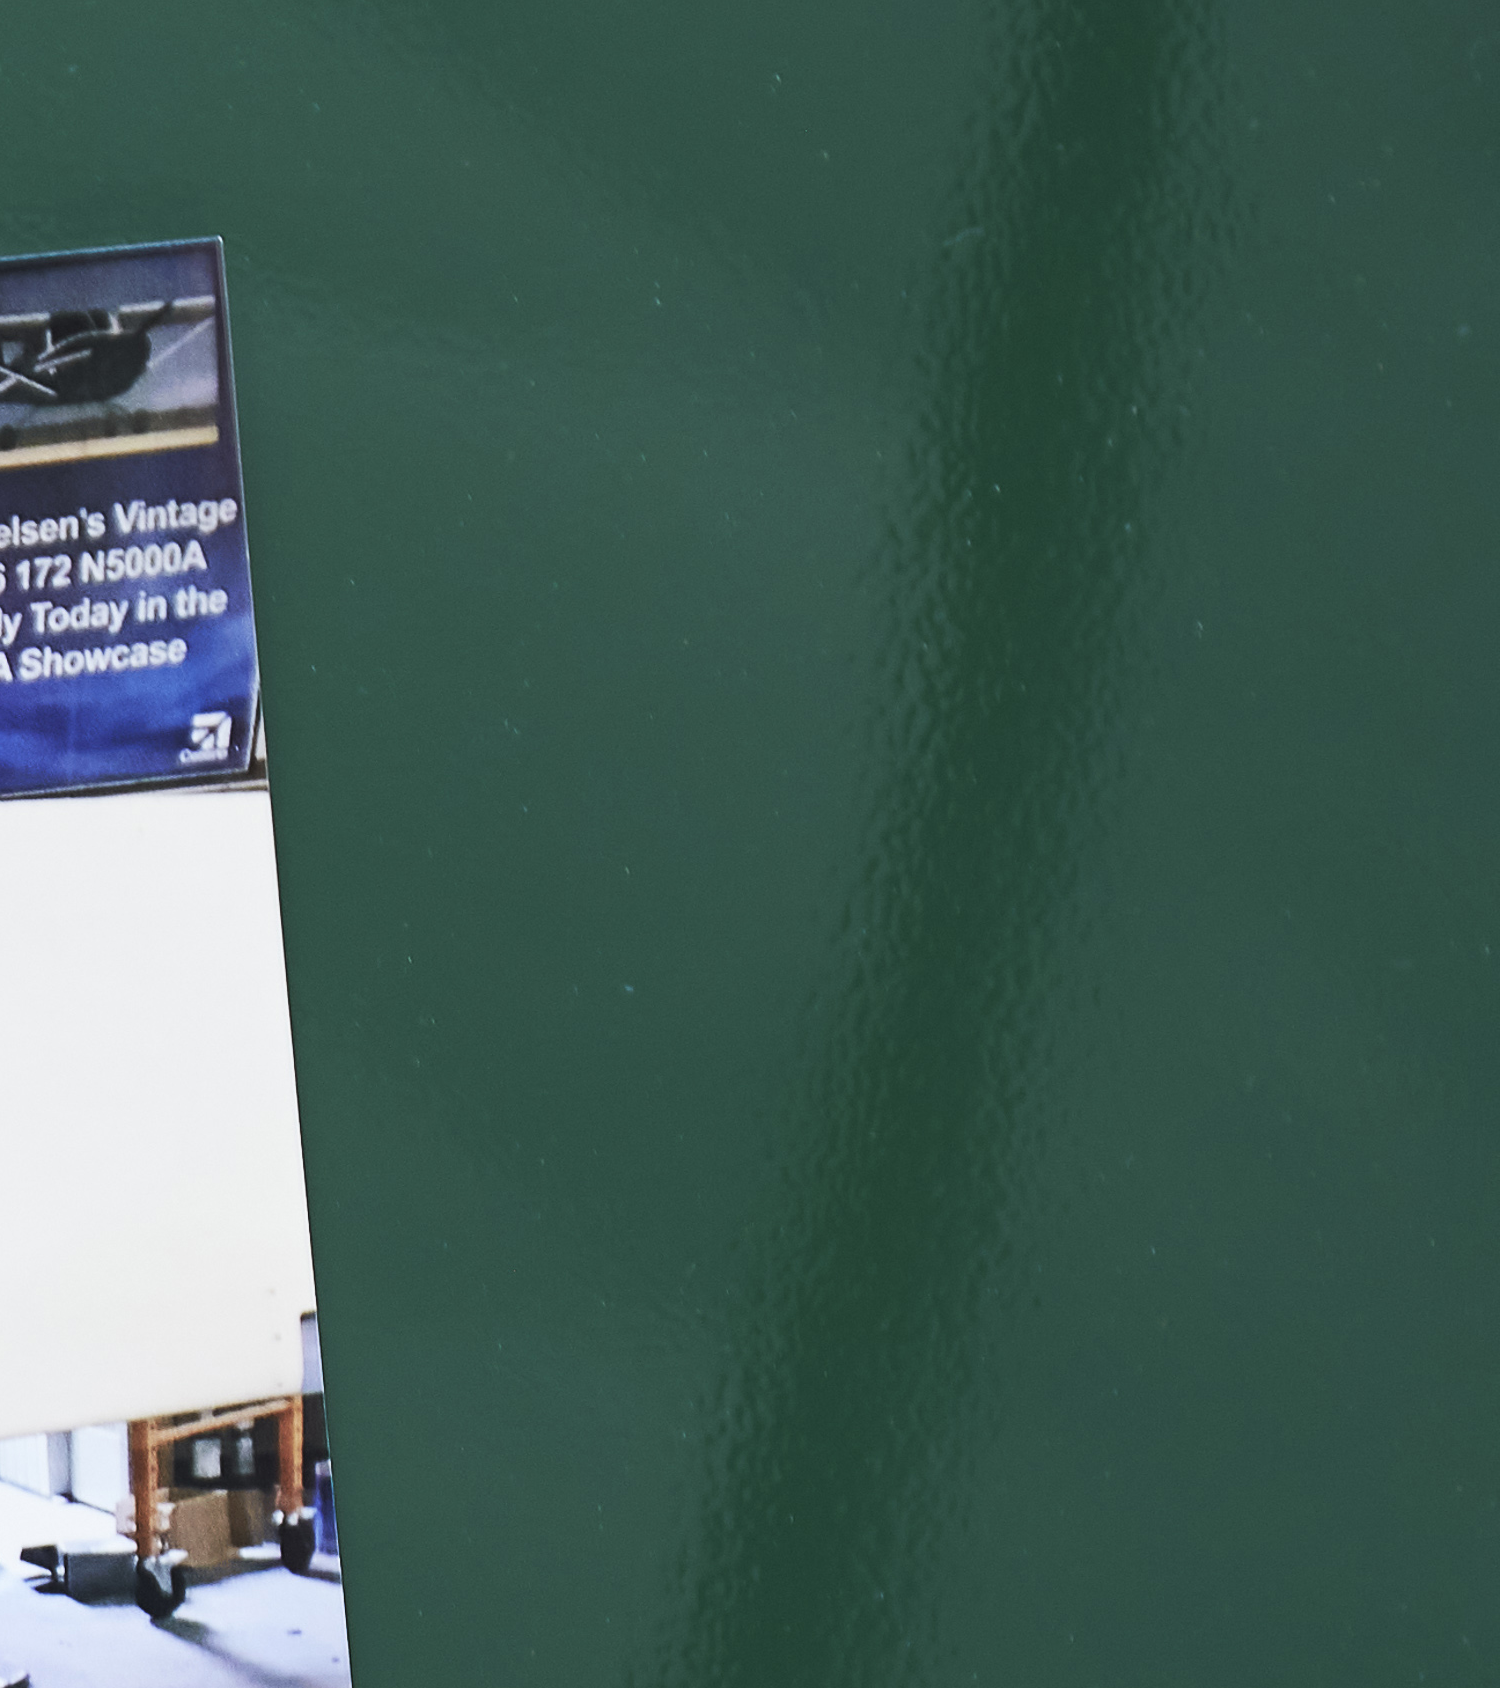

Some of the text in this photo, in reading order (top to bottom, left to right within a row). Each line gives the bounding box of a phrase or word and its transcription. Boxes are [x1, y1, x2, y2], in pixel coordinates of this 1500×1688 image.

[112, 497, 238, 534] Vintage
[15, 553, 73, 591] 172
[80, 539, 208, 584] N5000A
[29, 596, 130, 634] Today
[136, 590, 168, 622] in
[174, 584, 229, 619] the
[18, 637, 189, 681] Showcase
